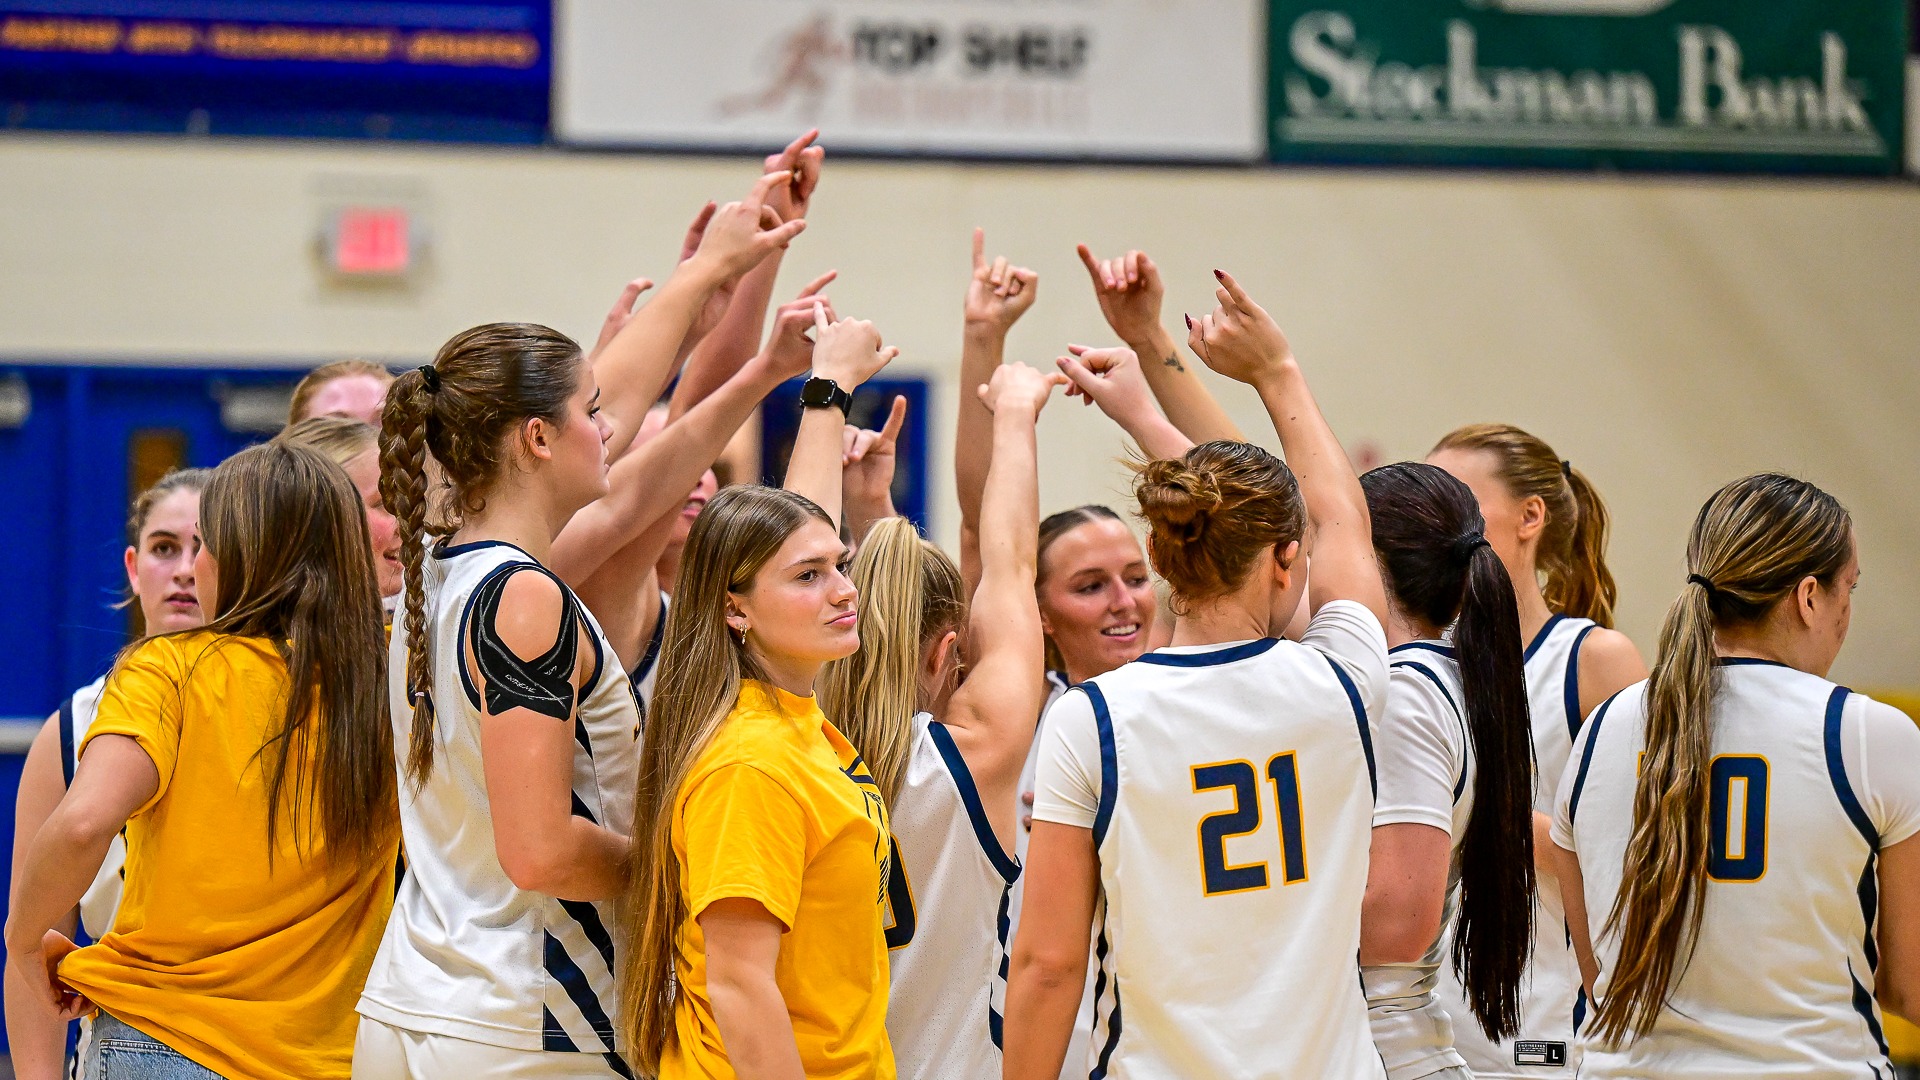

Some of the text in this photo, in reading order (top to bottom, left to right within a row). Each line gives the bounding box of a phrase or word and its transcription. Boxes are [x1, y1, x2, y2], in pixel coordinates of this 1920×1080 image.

[1285, 12, 1876, 131] Stockman Bank
[1190, 750, 1309, 897] 21
[1552, 1049, 1559, 1059] L
